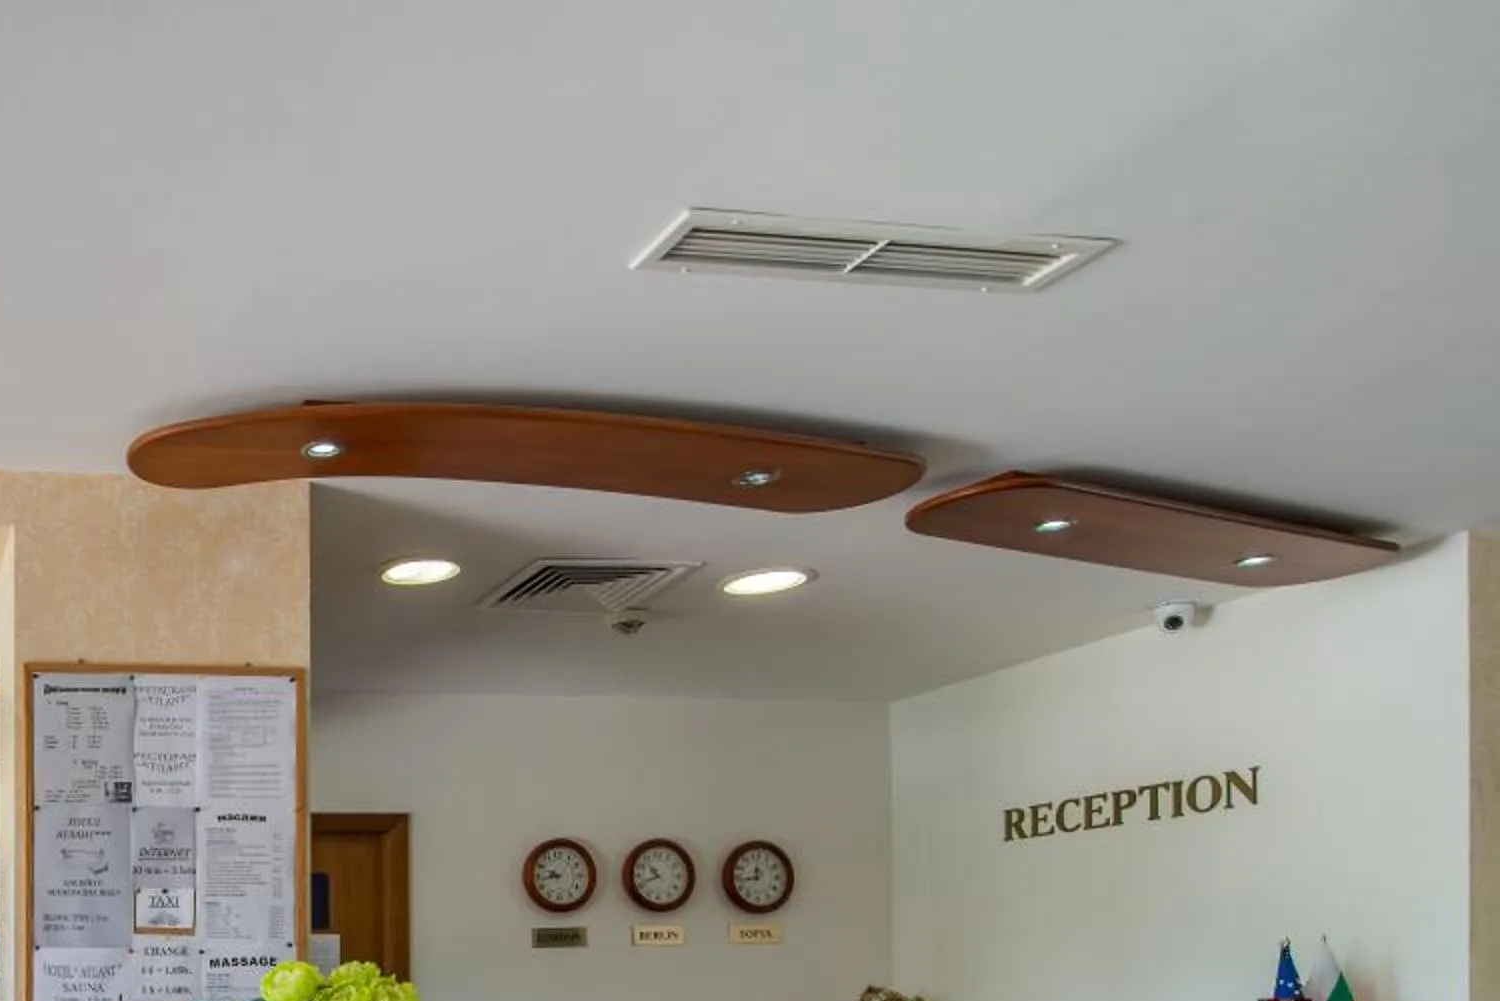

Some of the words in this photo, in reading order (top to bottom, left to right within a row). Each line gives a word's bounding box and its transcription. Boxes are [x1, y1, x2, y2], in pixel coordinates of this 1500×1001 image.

[1002, 765, 1261, 842] RECEPTION
[148, 895, 181, 908] TAXI
[639, 930, 678, 941] BERLIN
[209, 956, 277, 969] MASSAGE
